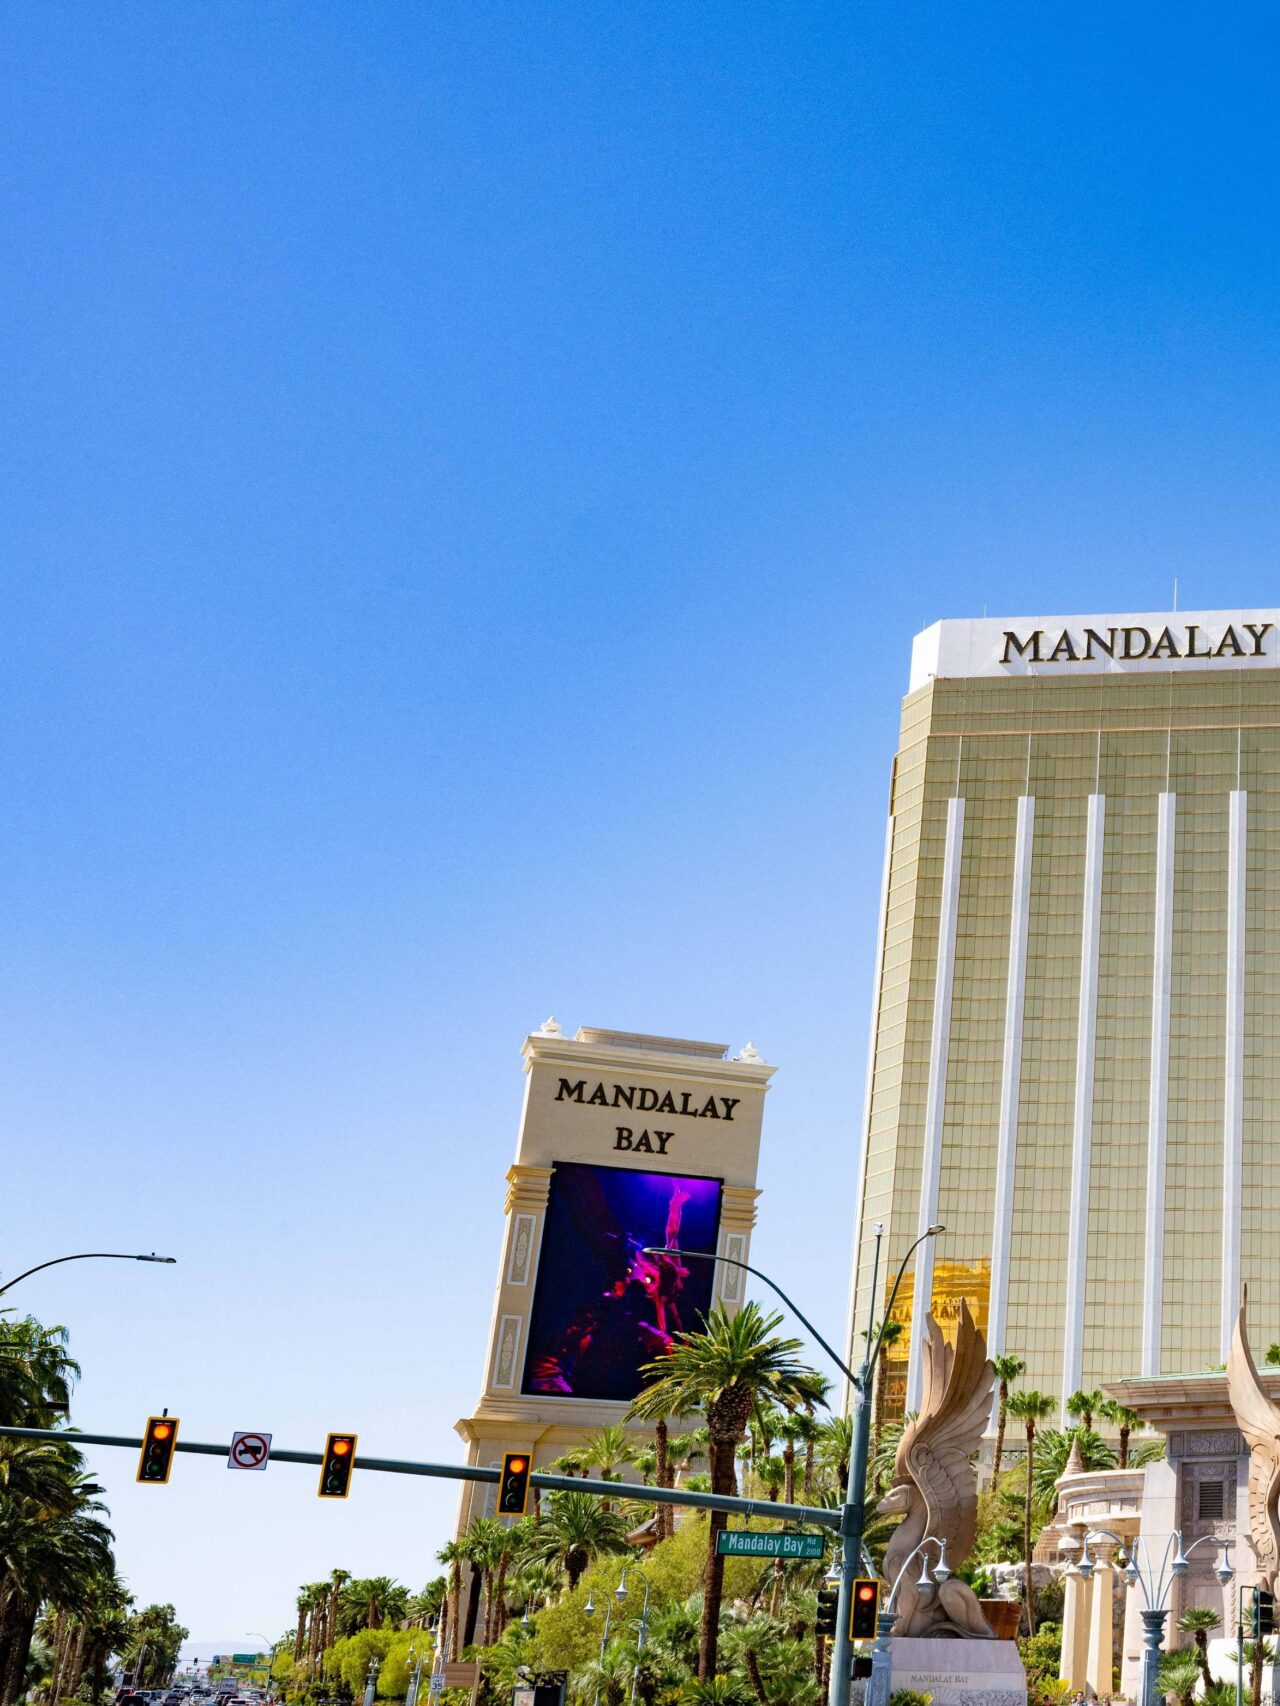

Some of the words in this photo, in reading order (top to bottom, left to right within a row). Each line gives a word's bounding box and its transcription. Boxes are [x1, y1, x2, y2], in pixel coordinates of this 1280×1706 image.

[999, 623, 1273, 664] MANDALAY
[554, 1078, 741, 1121] MANDALAY
[613, 1126, 675, 1155] BAY
[729, 1534, 781, 1555] Mandalay
[783, 1536, 804, 1556] Bay
[806, 1548, 821, 1556] 2100
[432, 1682, 443, 1691] 35
[910, 1674, 953, 1683] MANDALAY
[955, 1675, 969, 1684] BAY
